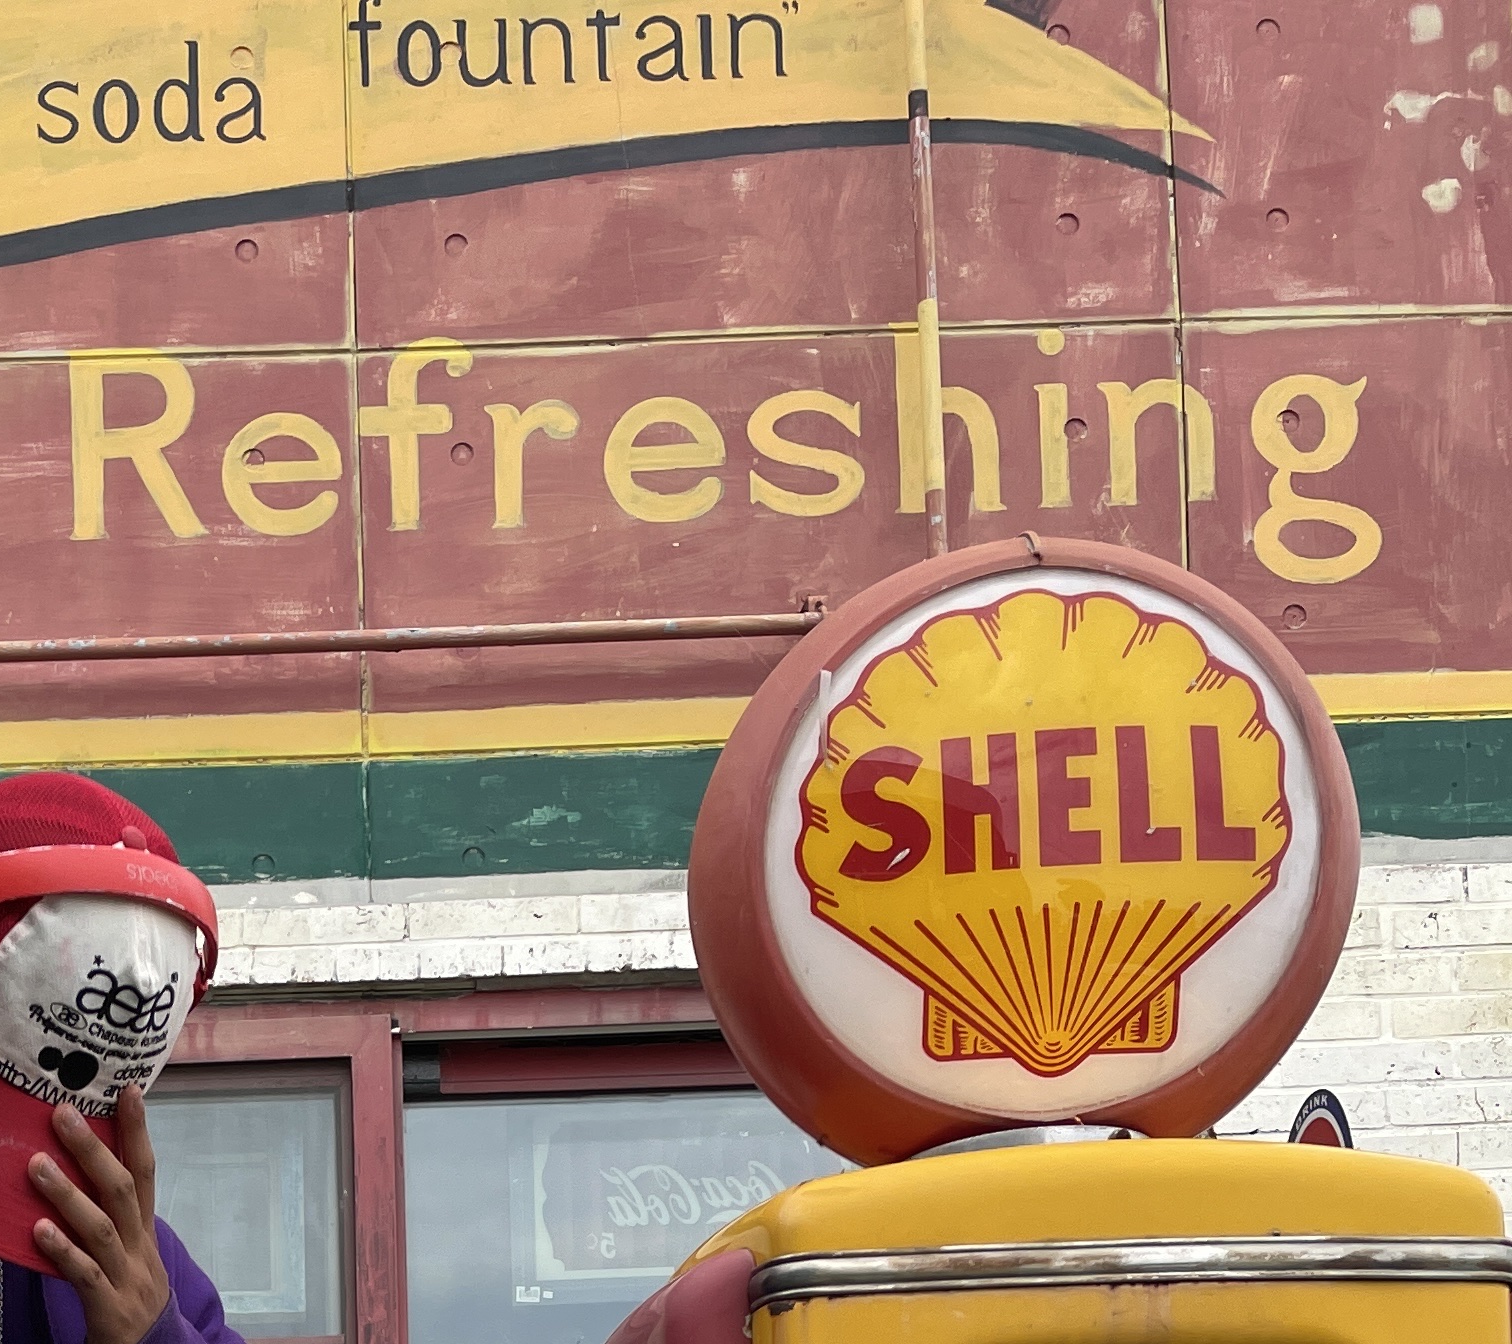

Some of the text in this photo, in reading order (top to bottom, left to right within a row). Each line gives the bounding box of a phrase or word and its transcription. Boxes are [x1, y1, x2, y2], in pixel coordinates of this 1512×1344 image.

[36, 40, 267, 144] soda
[68, 322, 1384, 585] Refreshing
[837, 724, 1257, 882] SHELL
[1295, 1094, 1328, 1131] DRINK
